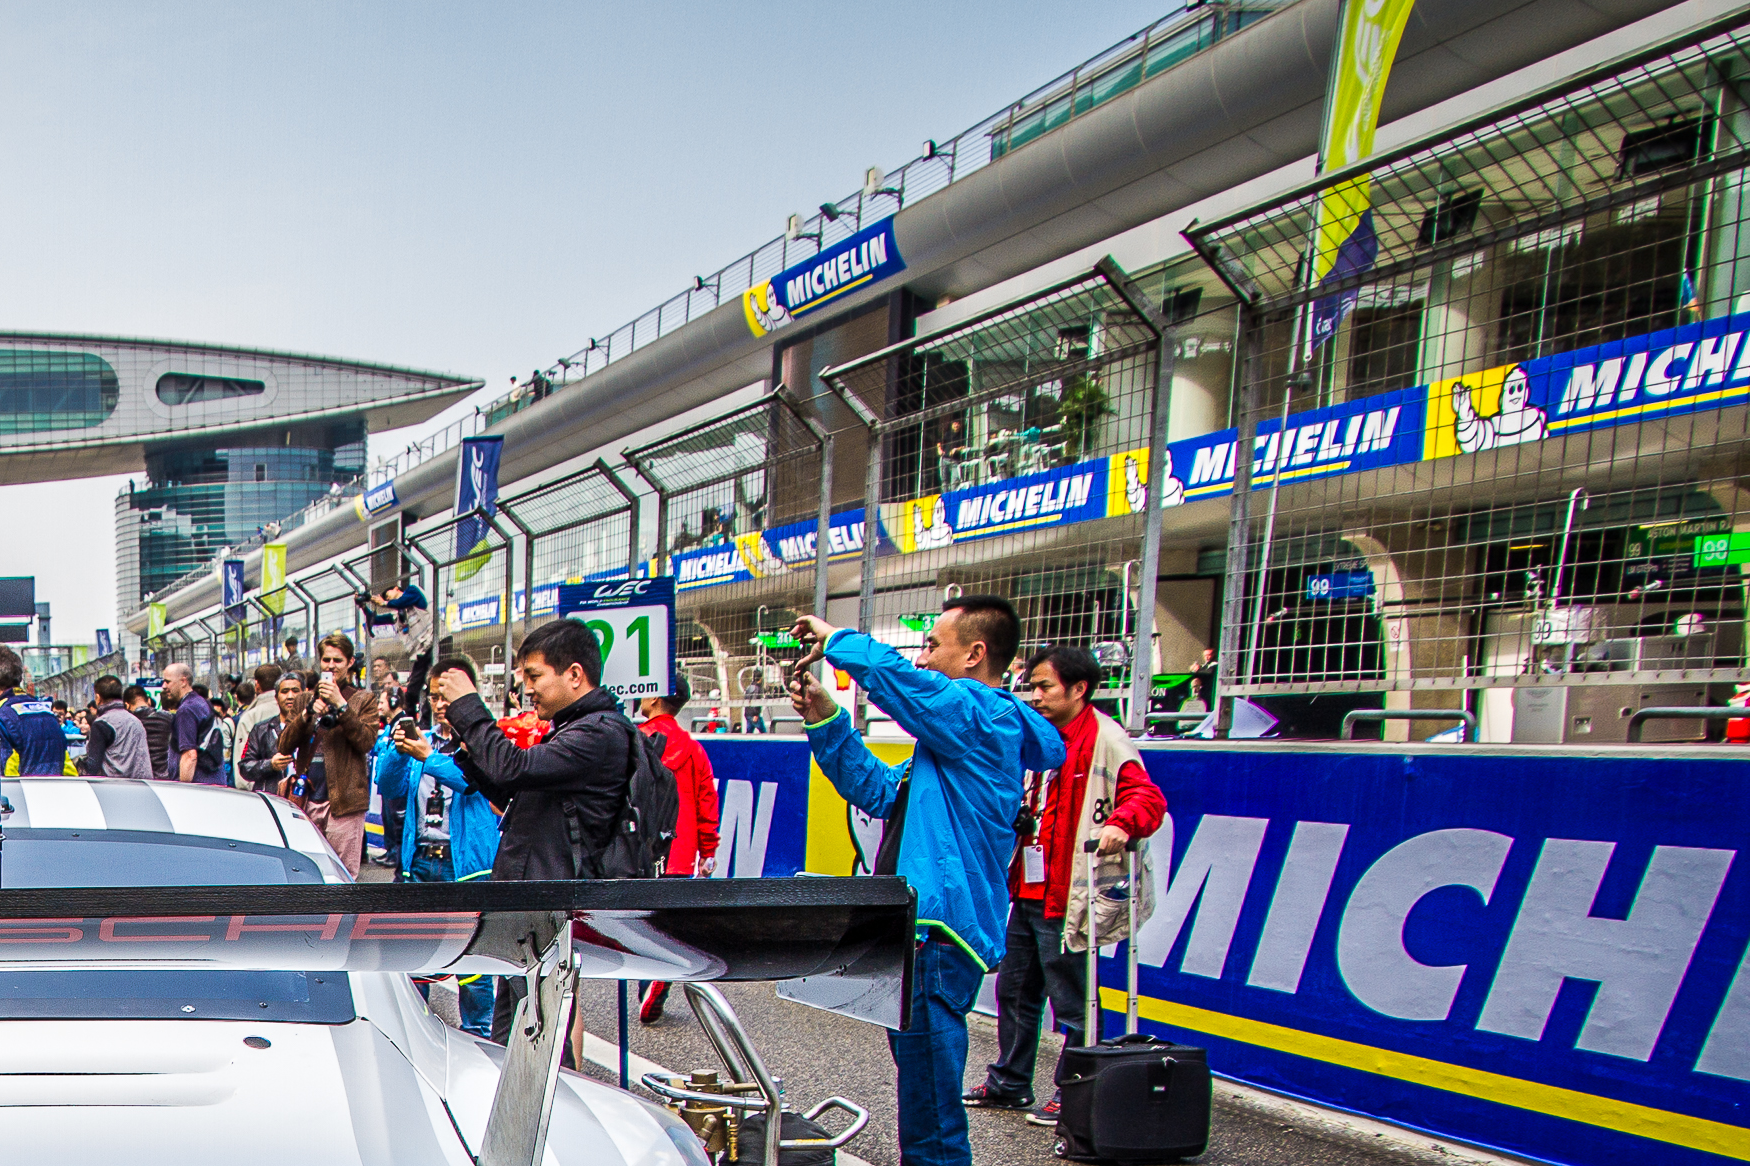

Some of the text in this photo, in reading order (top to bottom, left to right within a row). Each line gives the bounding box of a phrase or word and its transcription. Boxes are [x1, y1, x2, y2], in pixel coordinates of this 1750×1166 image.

[786, 232, 888, 308] MICHELIN
[1558, 330, 1750, 415] MICH
[956, 472, 1094, 531] MICHELIN
[1703, 539, 1728, 561] 98
[593, 580, 652, 598] WEC
[608, 682, 658, 695] ec.com
